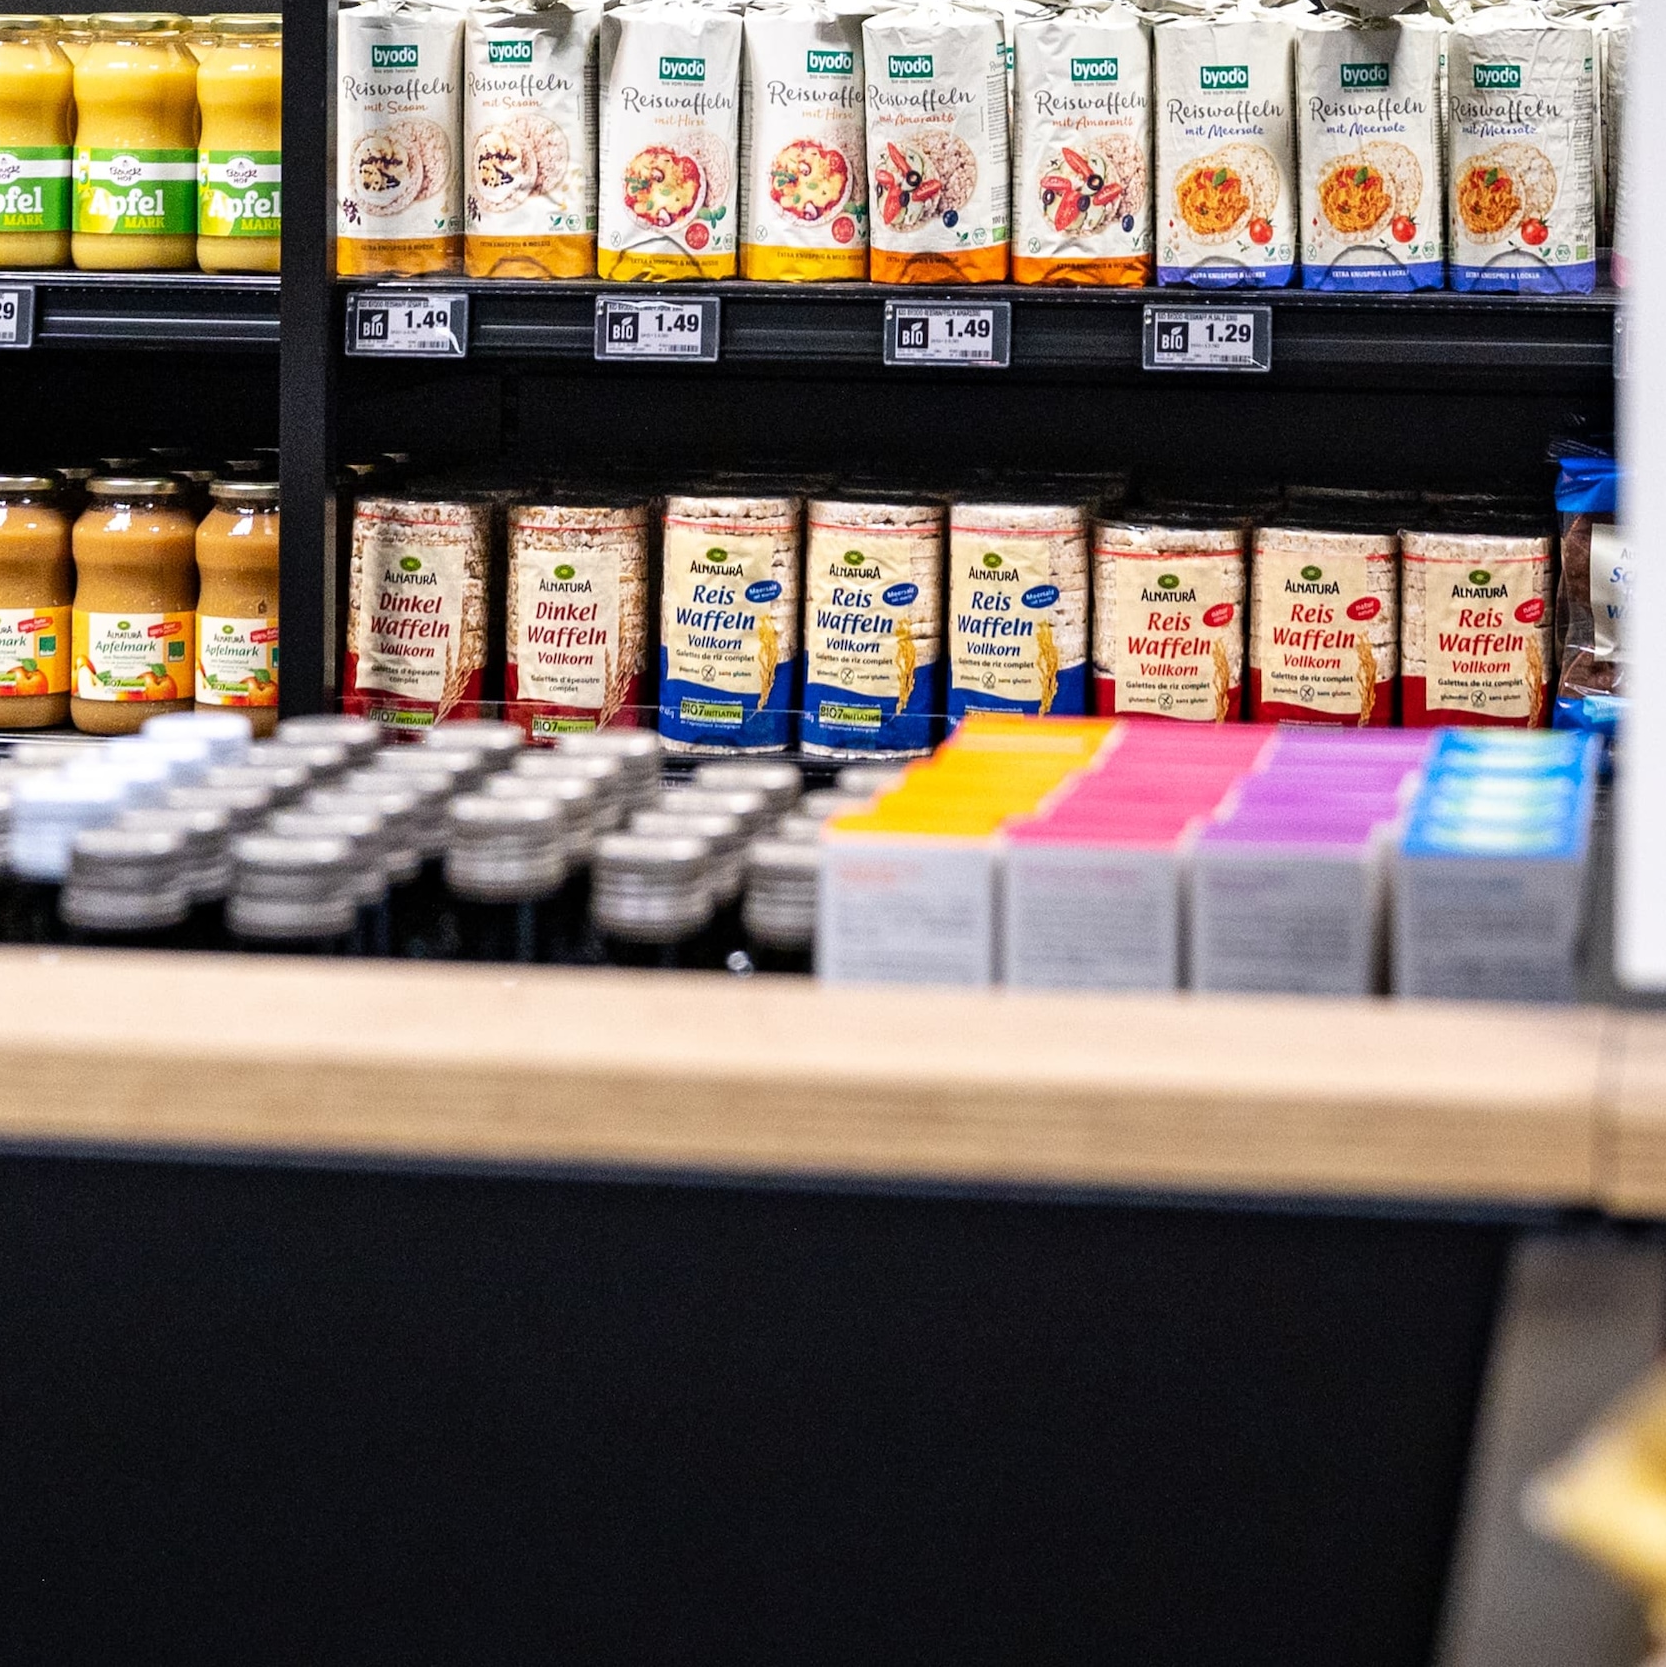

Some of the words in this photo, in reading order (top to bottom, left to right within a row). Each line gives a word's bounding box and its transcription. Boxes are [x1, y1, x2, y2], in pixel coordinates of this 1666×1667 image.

[374, 46, 417, 65] byodo
[490, 43, 532, 61] byodo
[809, 52, 852, 71] byodo
[661, 59, 704, 78] byodo
[890, 57, 933, 76] byodo
[1073, 60, 1117, 79] byodo
[1343, 65, 1388, 84] byodo
[1476, 67, 1519, 85] byodo
[1202, 67, 1247, 86] byodo
[1167, 98, 1284, 125] Reiswaffeln
[1309, 95, 1427, 123] Reiswaffeln
[88, 188, 166, 218] Apfel
[208, 190, 281, 220] Apfel
[4, 213, 44, 226] MARK
[124, 215, 165, 228] MARK
[241, 218, 281, 231] MARK
[655, 313, 700, 333] 1.49
[945, 318, 991, 338] 1.49
[1205, 323, 1252, 344] 1.29
[384, 569, 437, 585] ALNATURA
[690, 560, 744, 577] ALNATURA
[829, 563, 881, 579] ALNATURA
[969, 566, 1019, 582] ALNATURA
[539, 578, 592, 593] ALNATURA
[693, 584, 735, 605] Reis
[1141, 588, 1196, 602] ALNATURA
[1284, 578, 1340, 595] ALNATURA
[1451, 584, 1508, 598] ALNATURA
[379, 592, 442, 614] Dinkel
[832, 587, 872, 608] Reis
[971, 591, 1011, 611] Reis
[536, 601, 598, 622] Dinkel
[676, 607, 755, 632] Waffeln
[1290, 603, 1334, 624] Reis
[1458, 608, 1503, 629] Reis
[371, 615, 450, 641] Waffeln
[816, 609, 893, 634] Waffeln
[957, 613, 1033, 638] Waffeln
[1147, 612, 1191, 632] Reis
[527, 624, 607, 648] Waffeln
[687, 633, 742, 650] Vollkorn
[826, 637, 880, 653] Vollkorn
[1272, 627, 1355, 651] Waffeln
[1438, 632, 1523, 657] Waffeln
[95, 640, 157, 654] Apfelmark
[205, 644, 259, 658] Apfelmark
[380, 642, 435, 657] Vollkorn
[966, 641, 1021, 657] Vollkorn
[1128, 636, 1211, 658] Waffeln
[538, 651, 594, 666] Vollkorn
[1283, 653, 1341, 669] Vollkorn
[1451, 658, 1511, 674] Vollkorn
[1140, 662, 1199, 677] Vollkorn
